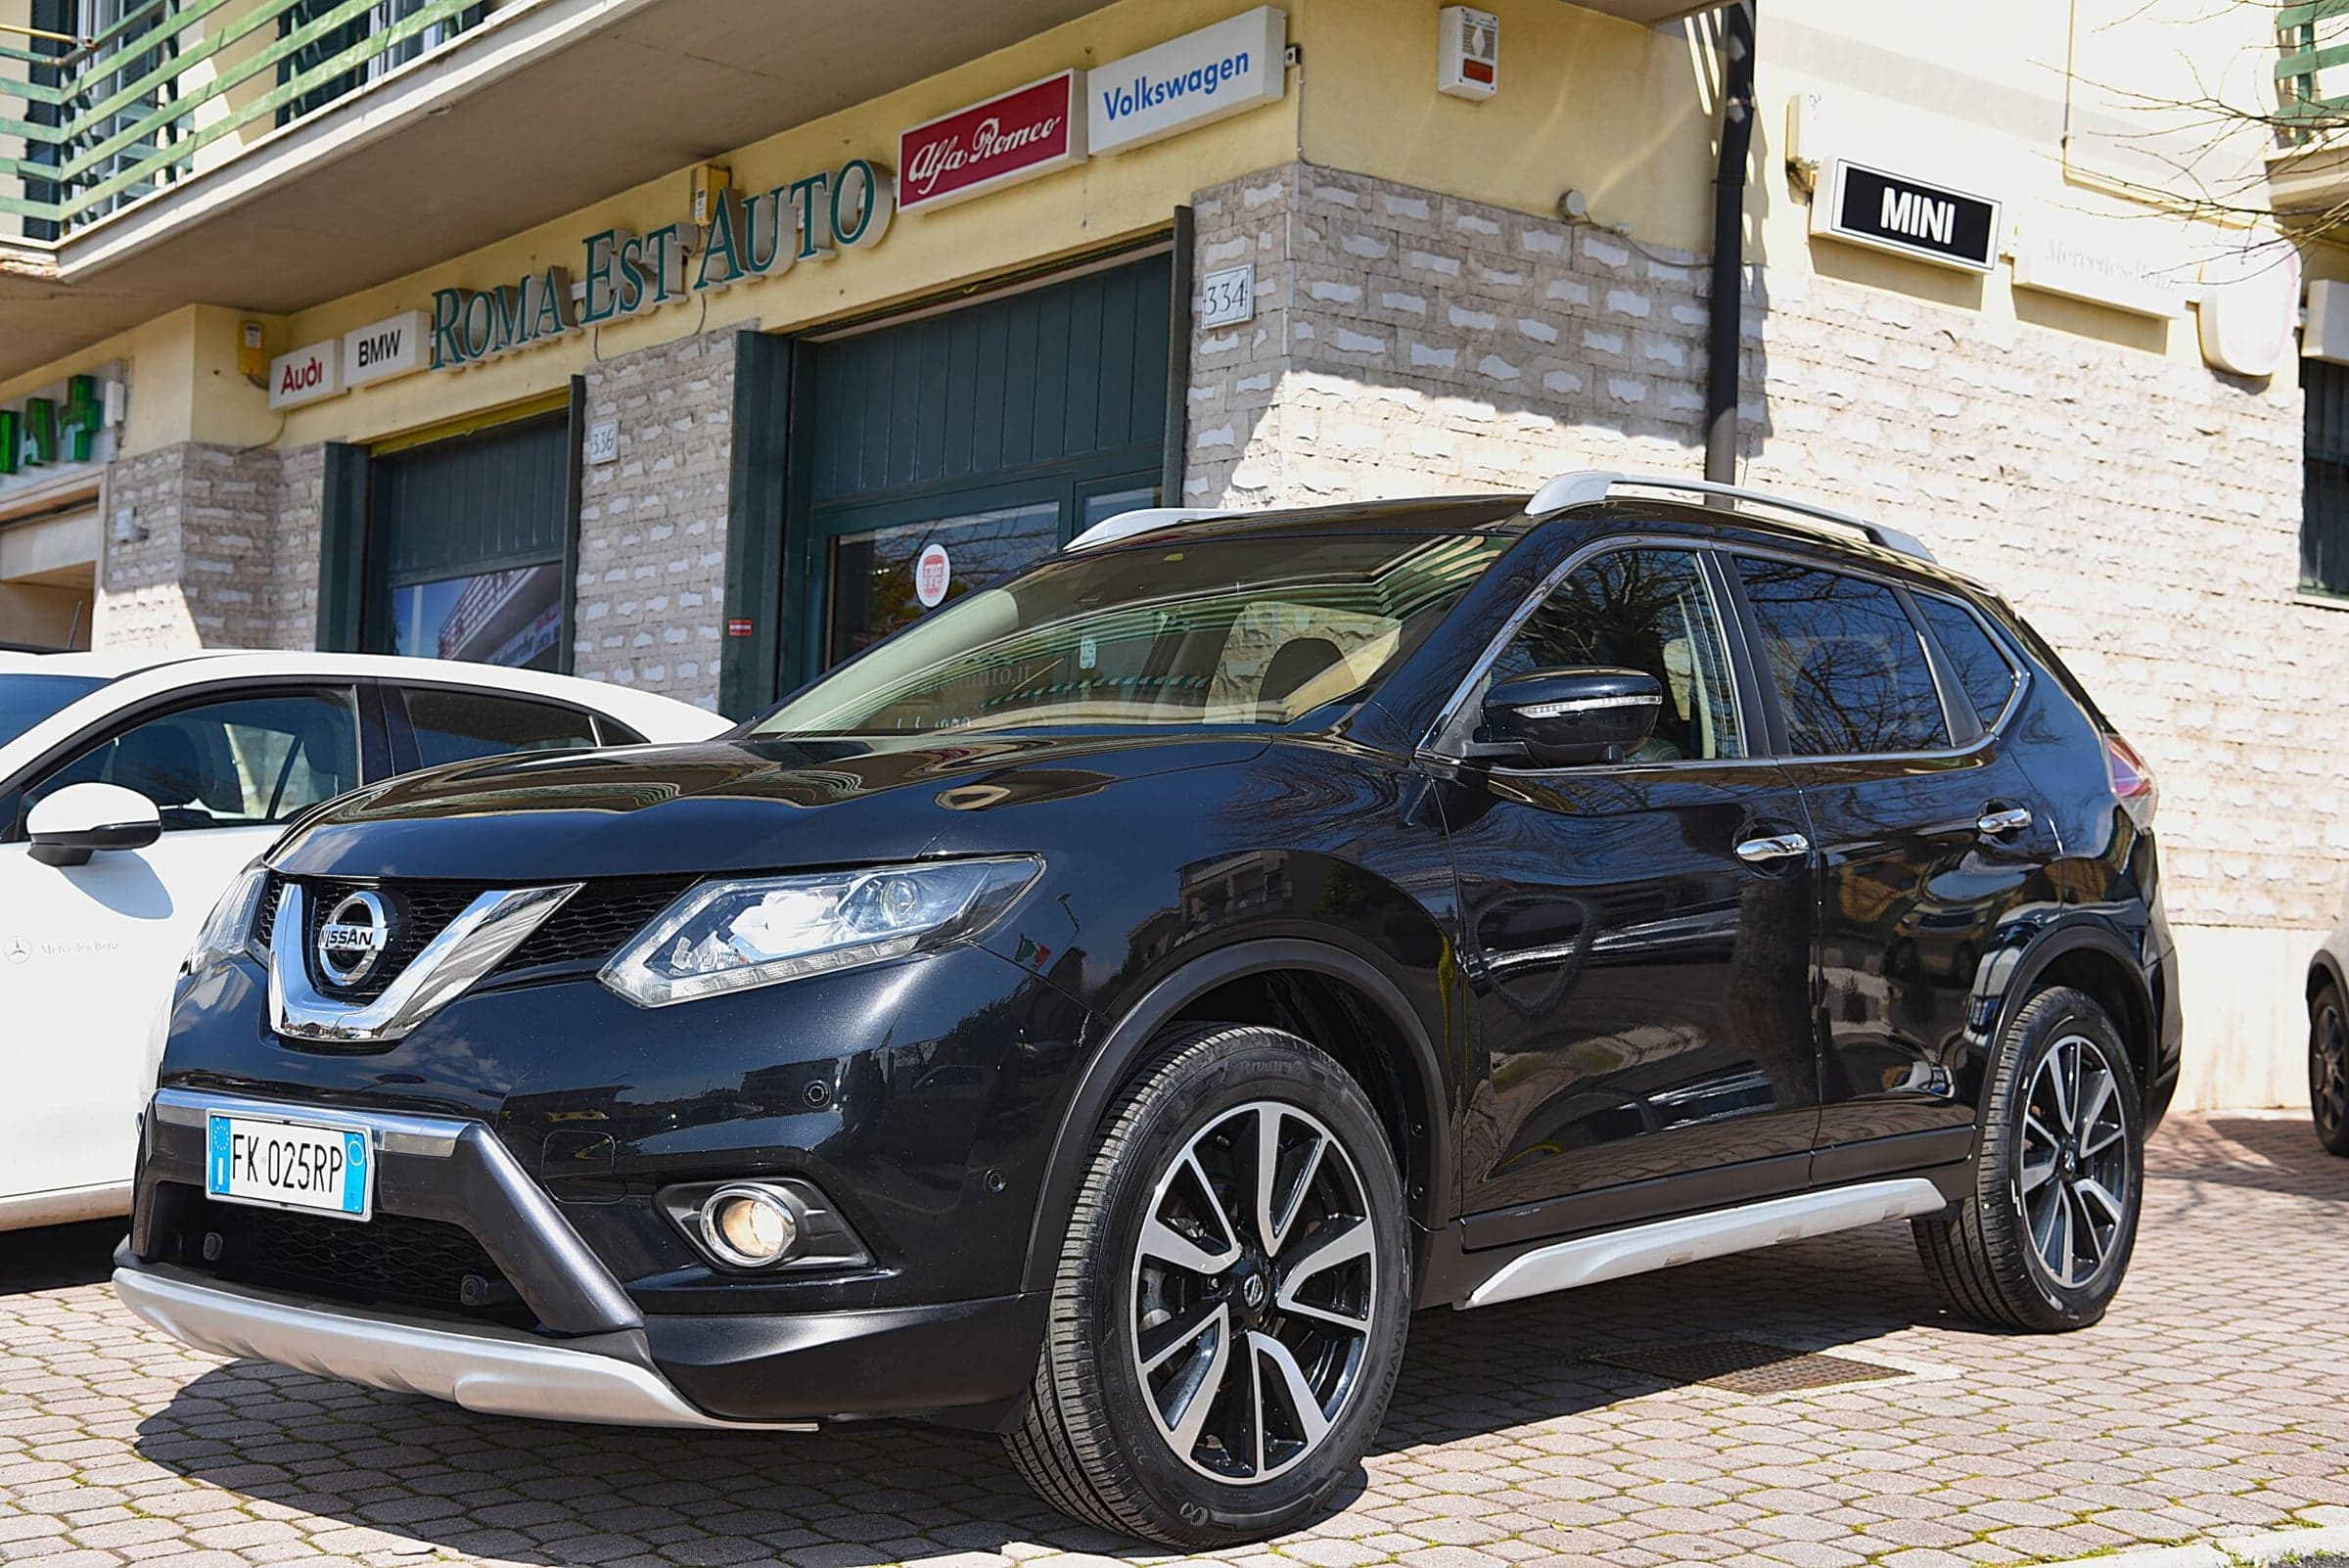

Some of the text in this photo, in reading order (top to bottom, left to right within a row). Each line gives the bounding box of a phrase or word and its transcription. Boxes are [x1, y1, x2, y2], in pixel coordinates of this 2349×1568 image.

[1104, 51, 1249, 120] Volkswagen
[907, 115, 1061, 195] Alfa Romeo
[1880, 186, 1956, 245] MINI
[430, 159, 875, 371] ROMA EST AUTO
[1205, 279, 1246, 316] 334
[280, 356, 322, 395] Audi
[358, 329, 401, 368] BMW
[320, 928, 374, 948] NISSAN
[232, 1133, 343, 1193] FK 025RP
